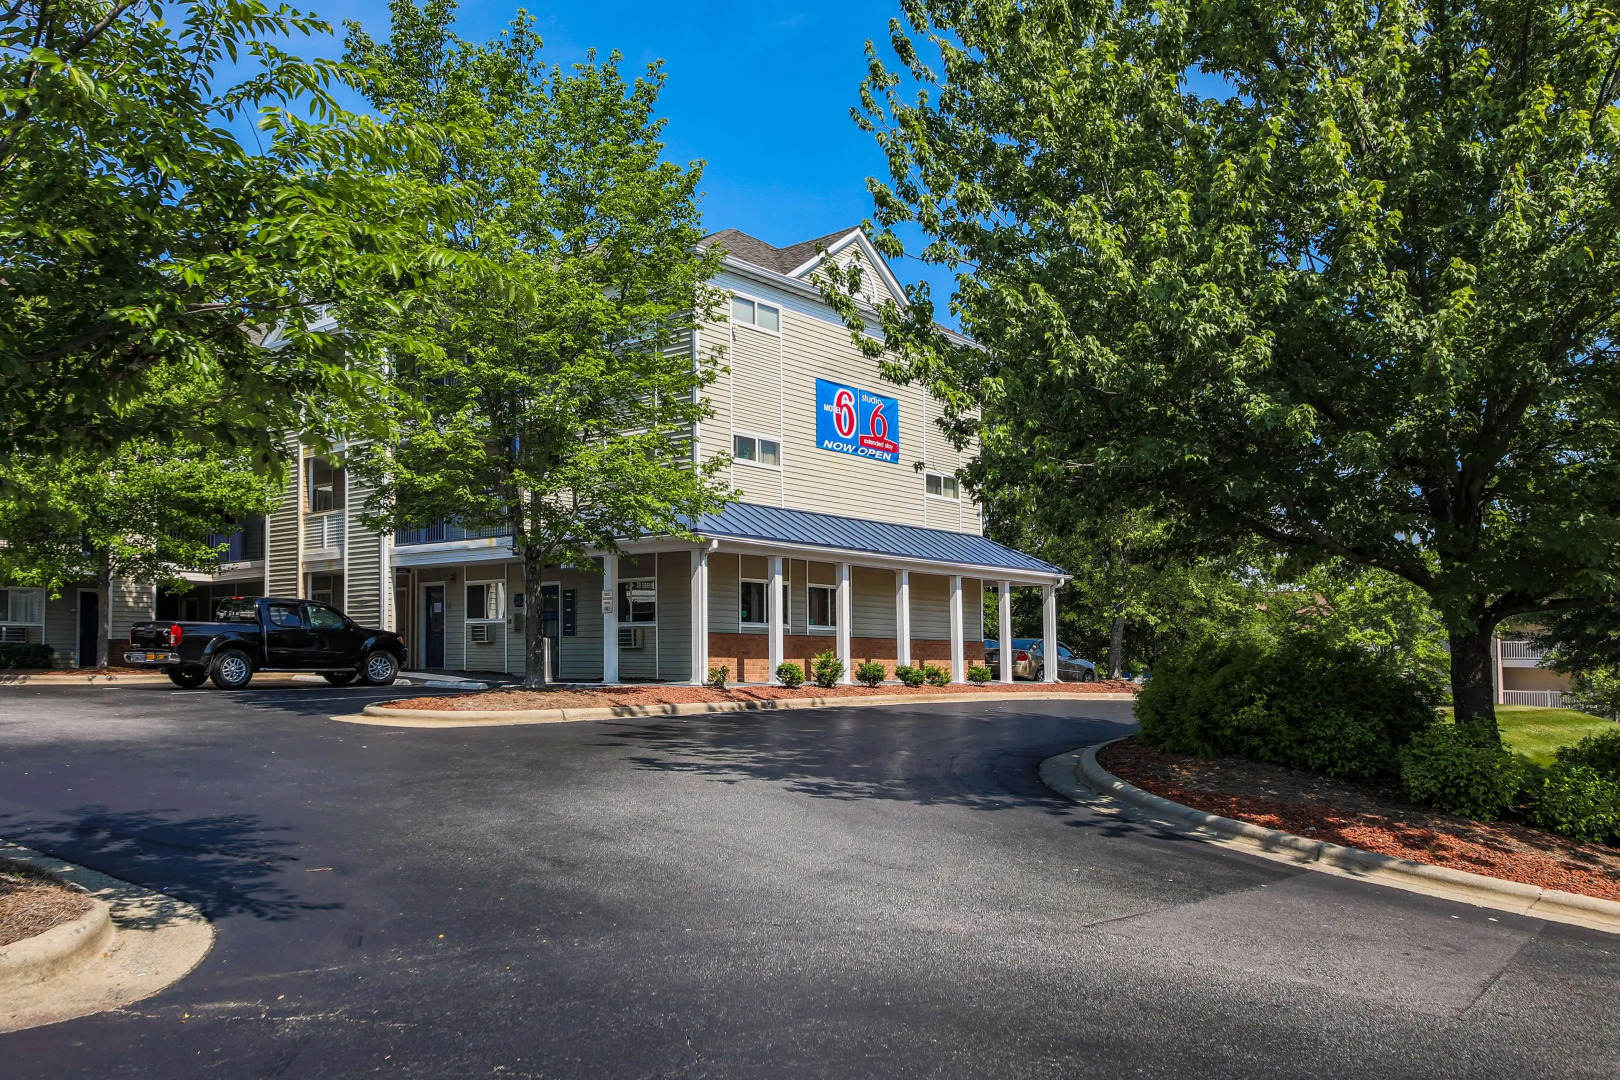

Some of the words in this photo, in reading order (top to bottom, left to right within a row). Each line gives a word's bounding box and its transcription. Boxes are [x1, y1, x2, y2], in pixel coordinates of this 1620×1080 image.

[862, 394, 882, 405] studio
[824, 404, 842, 414] MOTEL
[834, 388, 856, 439] 6
[870, 404, 888, 438] 6
[824, 440, 856, 453] NOW
[858, 447, 892, 460] OPEN
[864, 438, 884, 448] extended
[885, 441, 893, 450] stay
